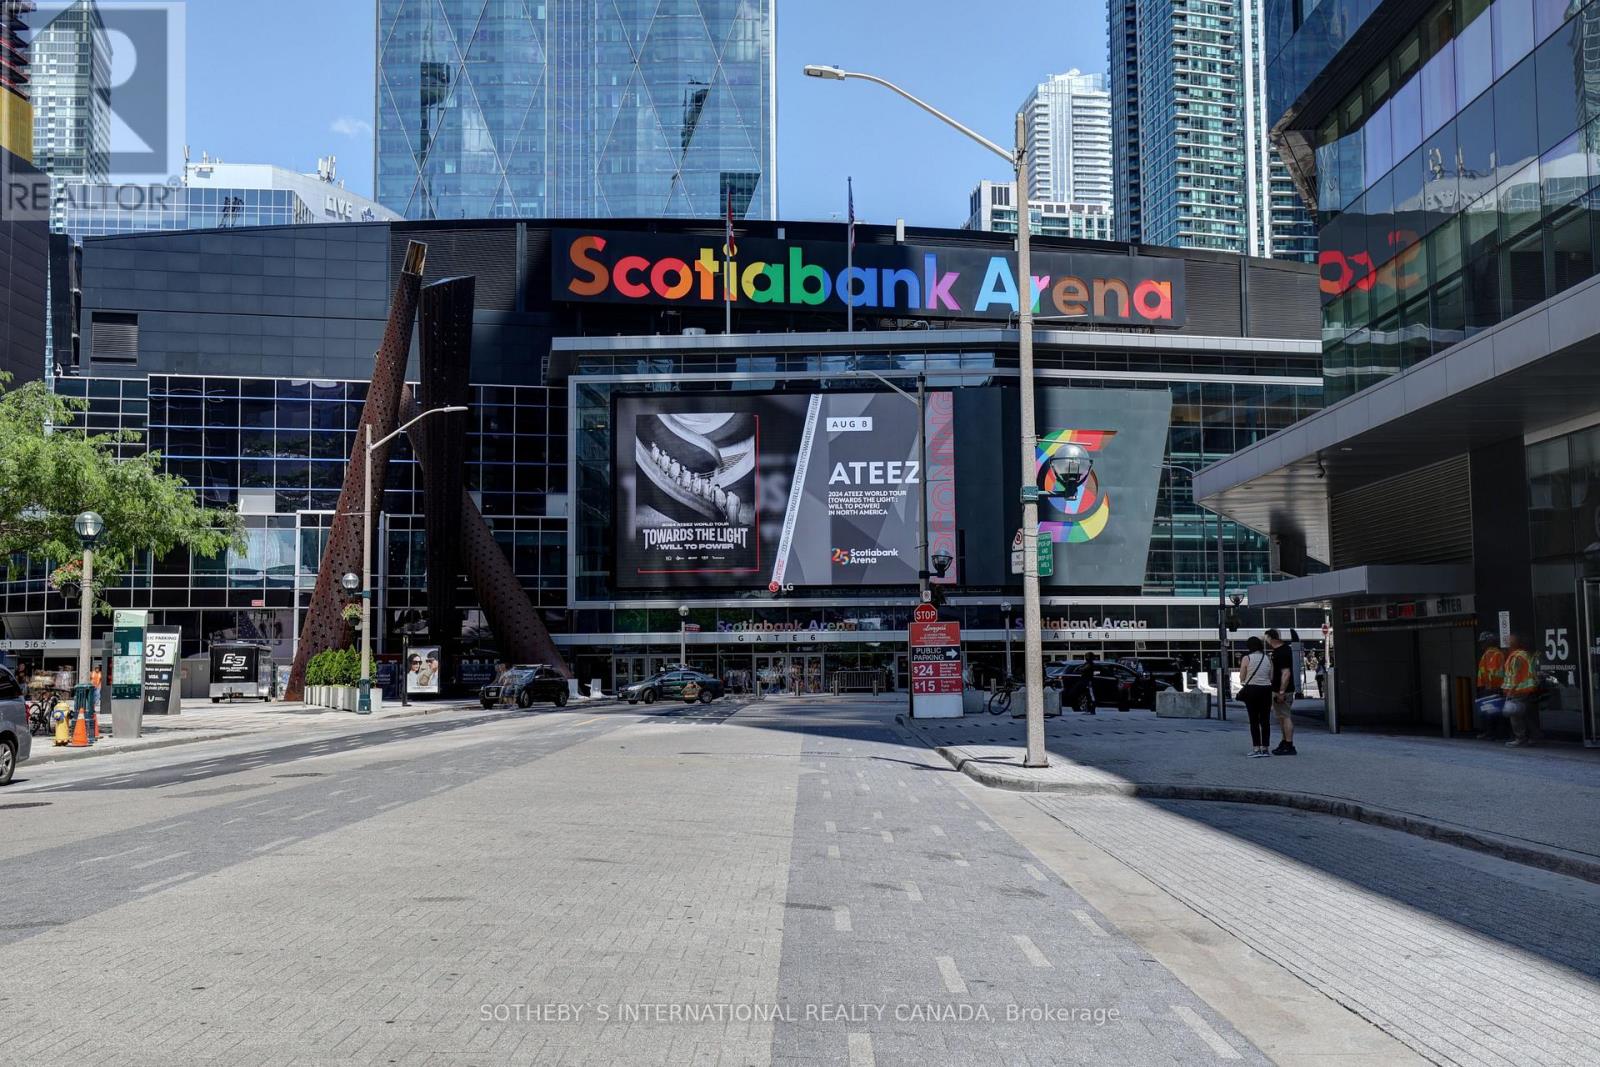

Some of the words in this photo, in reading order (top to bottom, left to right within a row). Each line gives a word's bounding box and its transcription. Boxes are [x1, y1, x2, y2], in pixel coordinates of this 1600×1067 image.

[568, 235, 961, 310] Scotiabank
[974, 256, 1172, 320] Arena
[828, 461, 920, 484] ATEEZ
[642, 528, 694, 550] TOWARDS
[695, 528, 715, 541] THE
[717, 528, 748, 548] LIGHT
[832, 547, 849, 564] 25
[850, 548, 899, 556] Scotiabank
[781, 583, 794, 591] LG
[1437, 598, 1462, 614] ENTER
[916, 611, 936, 620] STOP
[717, 618, 803, 632] Scotiabank
[808, 619, 856, 632] Arena
[1016, 618, 1098, 629] Stiabank
[1103, 618, 1147, 629] Arena
[146, 644, 166, 658] 35
[1545, 628, 1569, 660] 55
[914, 665, 934, 676] $24
[915, 680, 936, 692] $15
